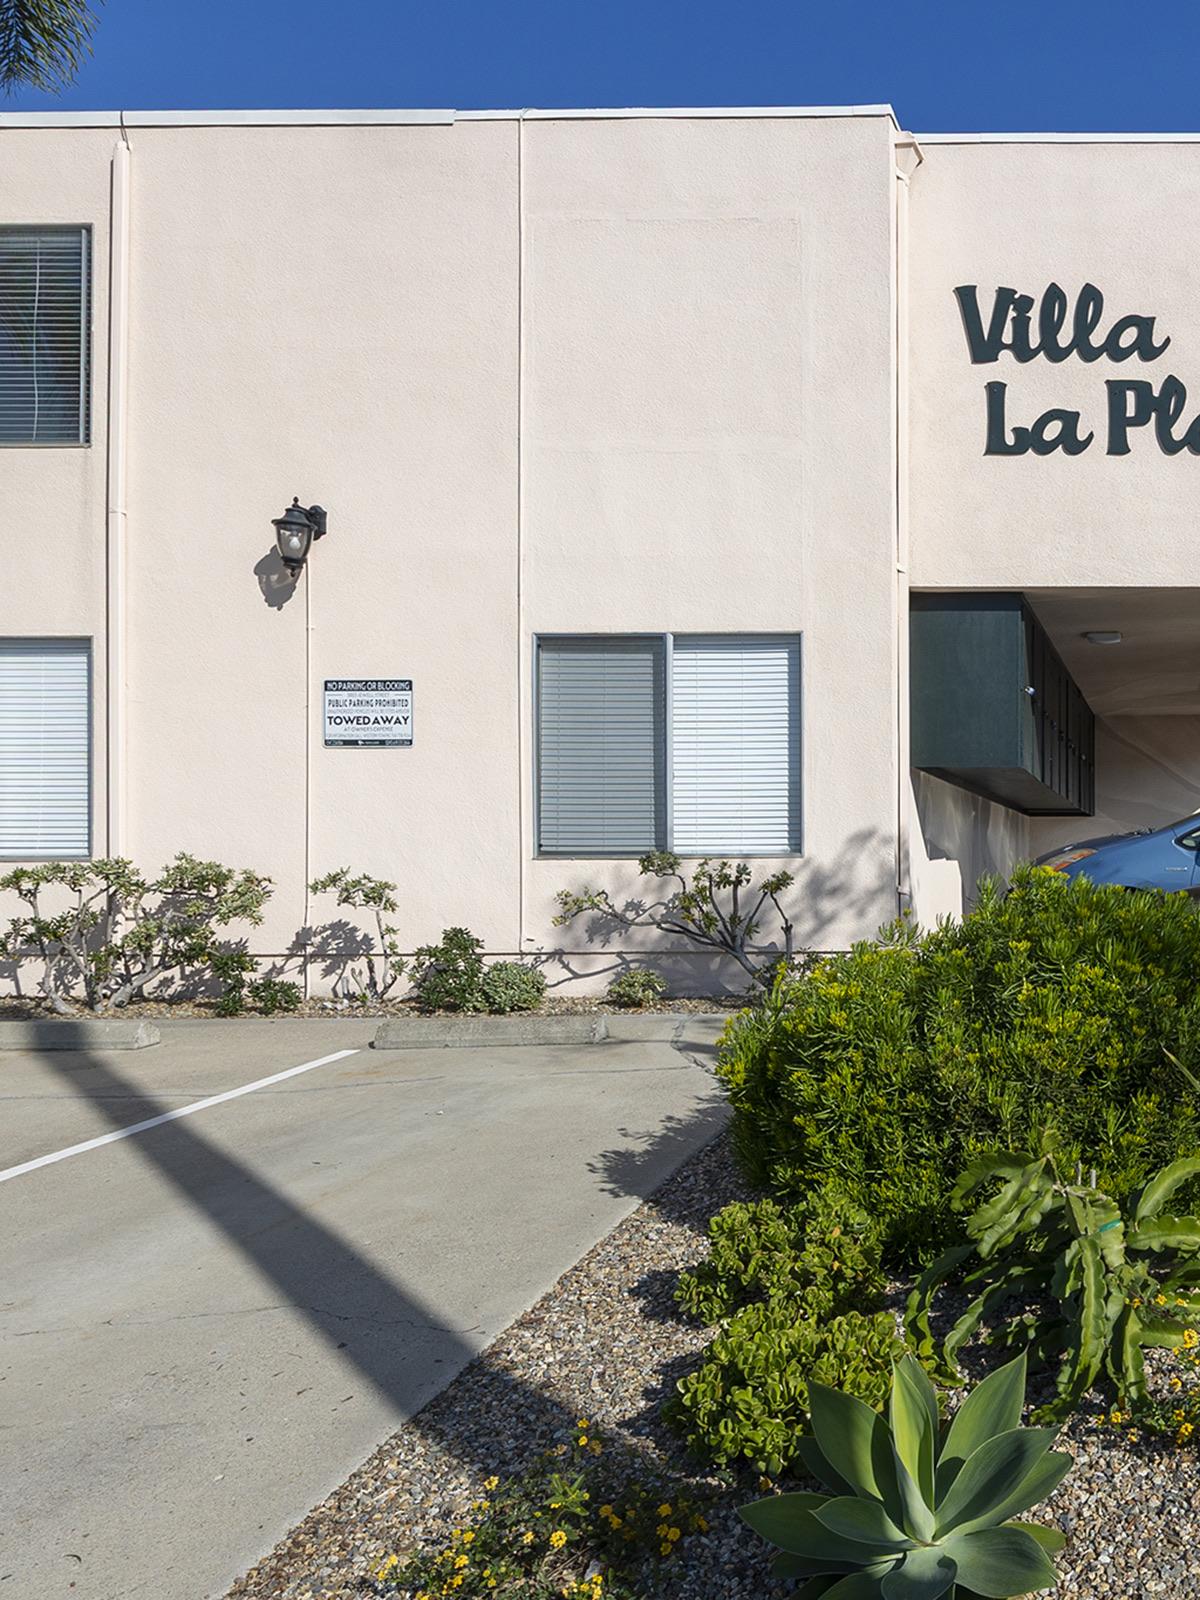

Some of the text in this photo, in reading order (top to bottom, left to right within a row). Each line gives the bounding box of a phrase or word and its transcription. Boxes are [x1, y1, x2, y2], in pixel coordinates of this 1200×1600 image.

[953, 282, 1171, 365] Villa
[983, 381, 1094, 457] La
[327, 681, 410, 691] NO PARKING OR BLOCKING
[328, 699, 409, 707] PUBLIC PARKING PROHIBITED
[327, 716, 410, 725] TOWED AWAY
